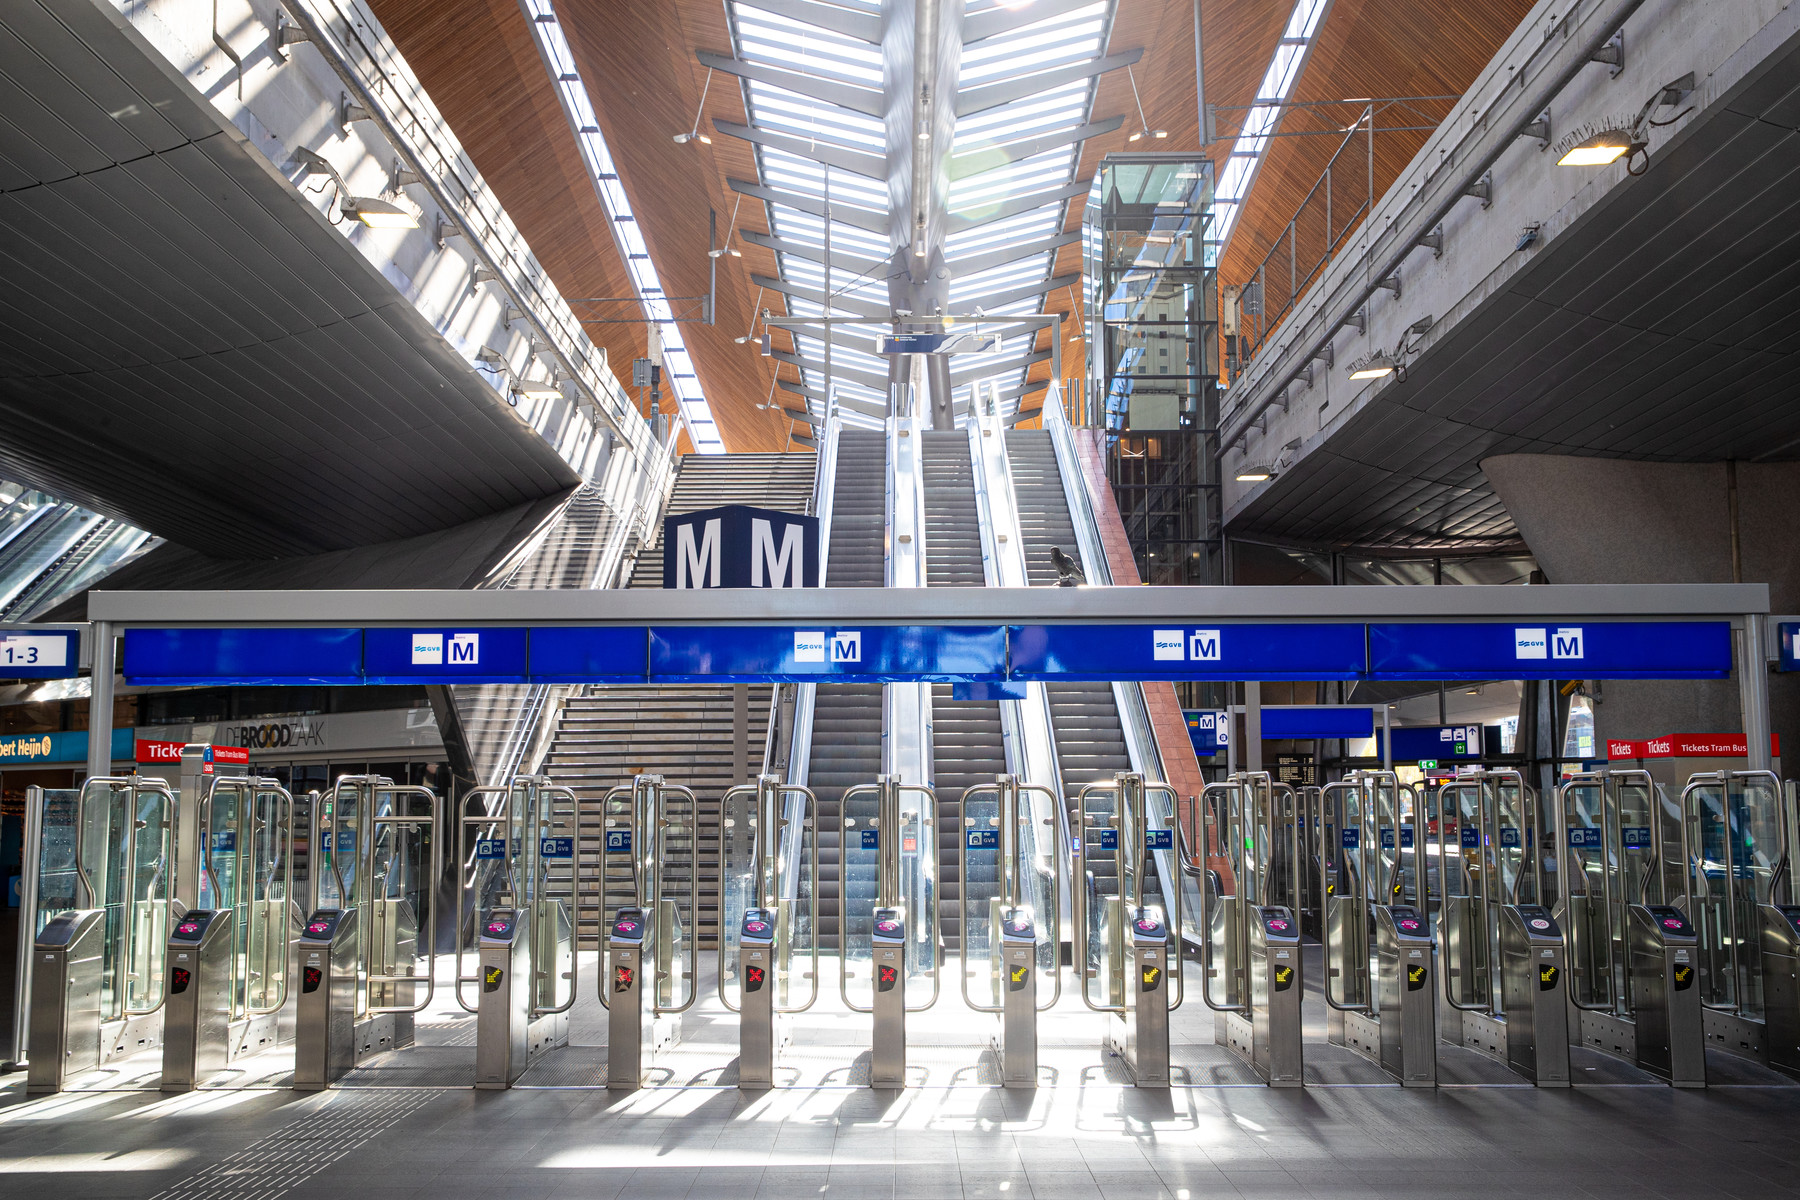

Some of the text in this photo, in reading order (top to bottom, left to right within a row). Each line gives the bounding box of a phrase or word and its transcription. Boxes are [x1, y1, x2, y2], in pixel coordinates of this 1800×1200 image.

[677, 518, 721, 589] M
[751, 518, 803, 588] M
[453, 642, 474, 661] M
[835, 640, 857, 660] M
[1194, 638, 1216, 658] M
[1556, 636, 1579, 656] M
[1202, 718, 1213, 728] M
[18, 738, 41, 759] Heijn
[1611, 742, 1632, 756] Tickets
[1648, 740, 1670, 755] Tickets
[1681, 744, 1747, 752] Tickets Tram Bus
[204, 764, 213, 772] SOS
